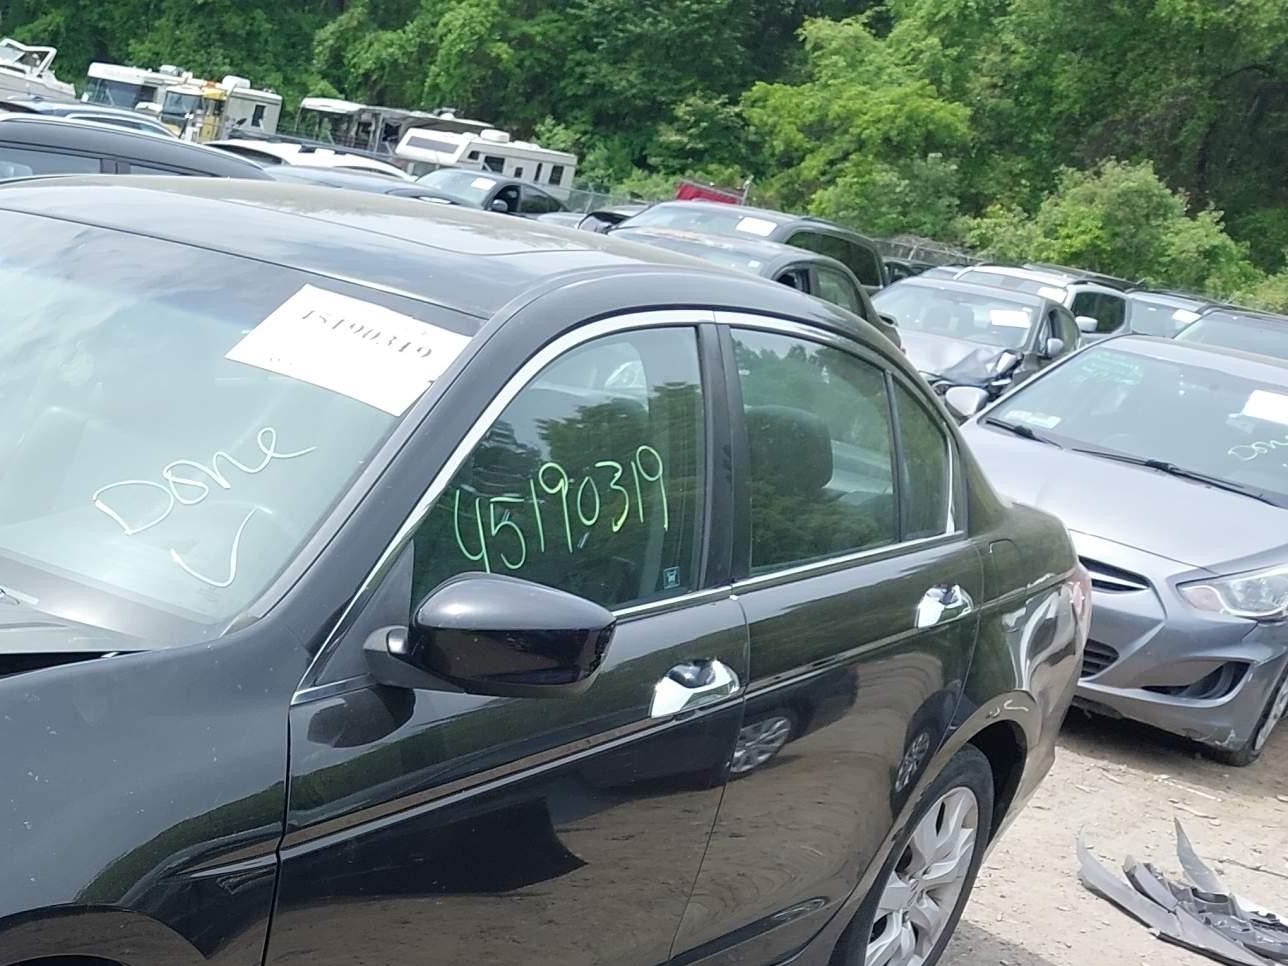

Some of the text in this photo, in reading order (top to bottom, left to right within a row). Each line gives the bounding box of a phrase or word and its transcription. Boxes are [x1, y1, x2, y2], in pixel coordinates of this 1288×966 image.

[92, 427, 317, 535] Done
[1227, 435, 1288, 461] Don
[454, 445, 669, 574] 45190319
